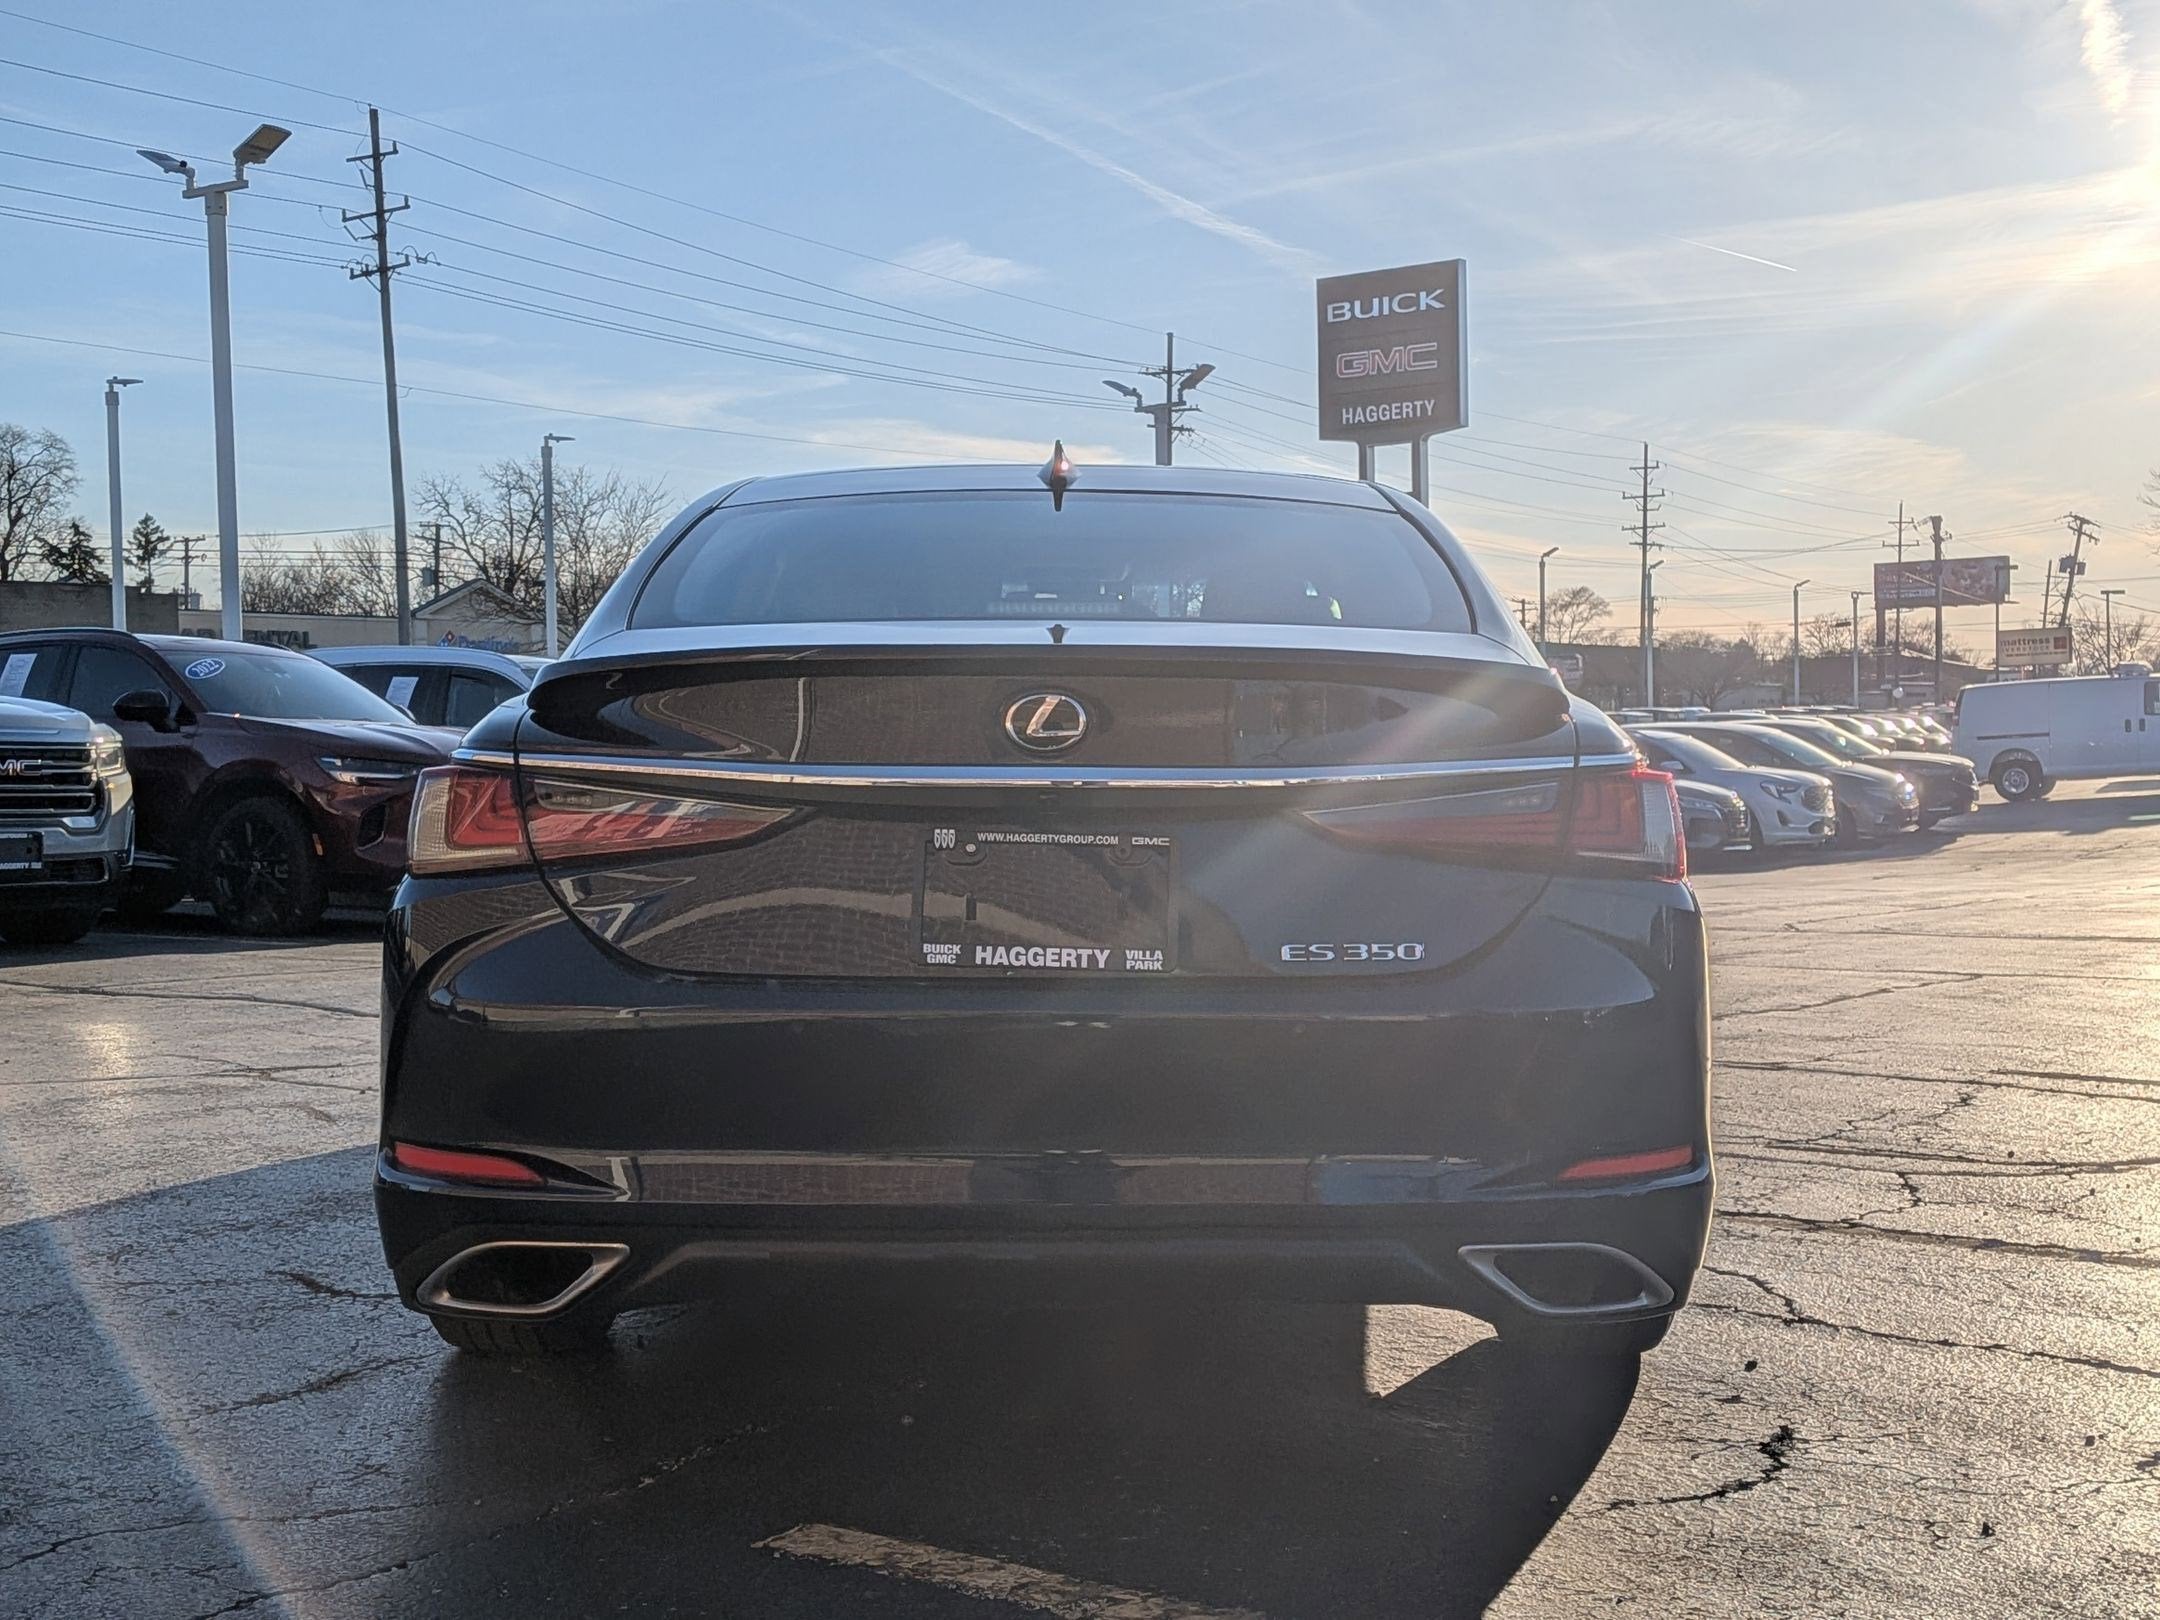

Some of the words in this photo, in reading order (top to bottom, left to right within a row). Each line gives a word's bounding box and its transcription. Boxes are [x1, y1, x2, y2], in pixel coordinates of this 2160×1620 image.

[1326, 288, 1446, 323] BUICK
[1336, 342, 1438, 379] GMC
[1342, 399, 1436, 425] HAGGERTY
[2000, 637, 2050, 647] mattress
[191, 659, 220, 677] 2022
[0, 759, 41, 776] MC
[977, 832, 1119, 845] WWW.HAGGERTYGROUP.COM
[1131, 836, 1170, 846] GMC
[923, 943, 962, 955] BUICK
[1125, 949, 1164, 961] VILLA
[1281, 943, 1336, 961] ES
[1343, 943, 1423, 961] 350
[926, 953, 957, 965] GMC
[975, 945, 1111, 969] HAGGERTY
[1125, 959, 1164, 971] PARK
